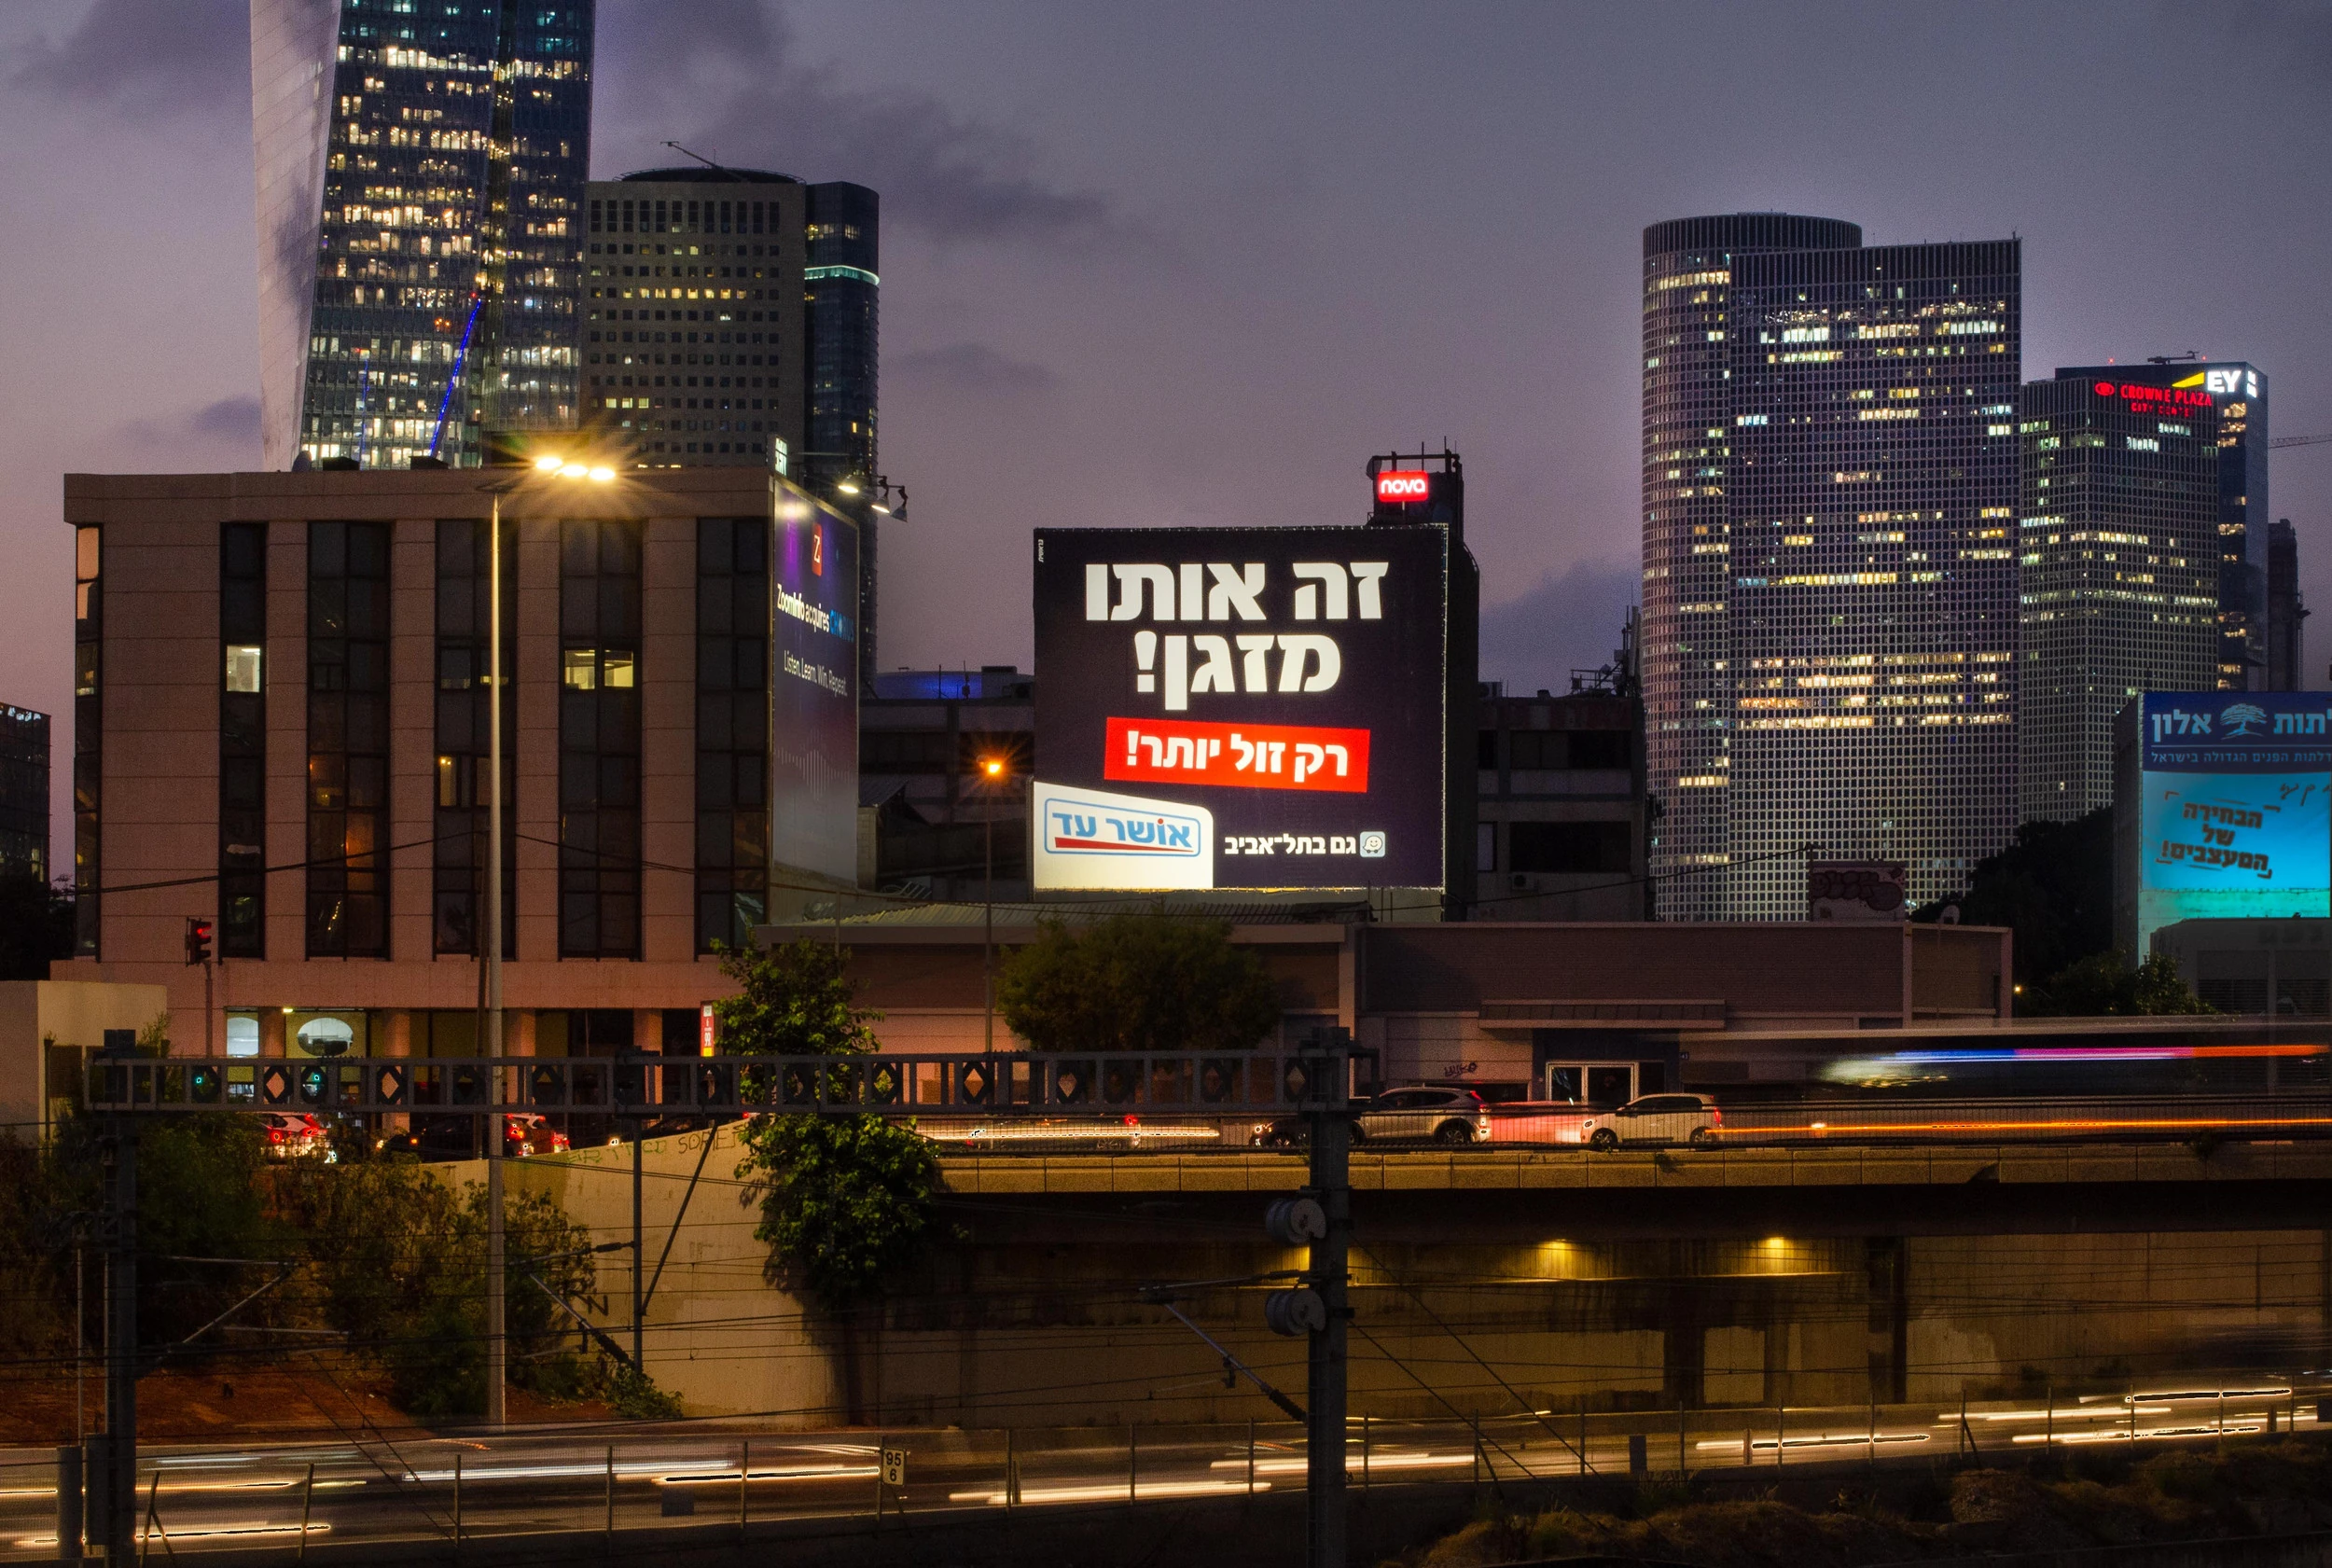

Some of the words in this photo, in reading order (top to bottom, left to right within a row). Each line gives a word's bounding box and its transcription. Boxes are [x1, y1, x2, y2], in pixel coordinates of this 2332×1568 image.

[2207, 370, 2242, 393] EY
[2119, 383, 2172, 404] CROWNE
[2174, 389, 2213, 407] PLAZA
[2131, 401, 2154, 413] CITY
[1380, 479, 1426, 495] nova
[1086, 562, 1267, 621] אותו
[1292, 562, 1389, 620] זה
[777, 583, 806, 621] ZoomInfo
[805, 603, 829, 632] acquires
[784, 650, 801, 677] Listen.
[801, 658, 817, 684] Learn.
[817, 664, 828, 688] Win.
[828, 670, 848, 698] Repeat.
[1133, 631, 1341, 711] מזגן!
[2151, 708, 2212, 743] אלון
[1127, 730, 1220, 770] יותר!
[1229, 733, 1286, 773] זול
[1294, 742, 1348, 783] רק
[2151, 751, 2199, 763] בישראל
[2203, 751, 2247, 762] הגדולה
[2253, 752, 2288, 762] הפנים
[1052, 812, 1097, 838] עד
[2183, 802, 2263, 829] הבחירה
[1104, 818, 1190, 848] אושר
[1329, 836, 1357, 855] גם
[2201, 824, 2236, 846] של
[2161, 840, 2270, 871] המעצבים!
[886, 1451, 901, 1466] 95
[890, 1468, 897, 1481] 6
